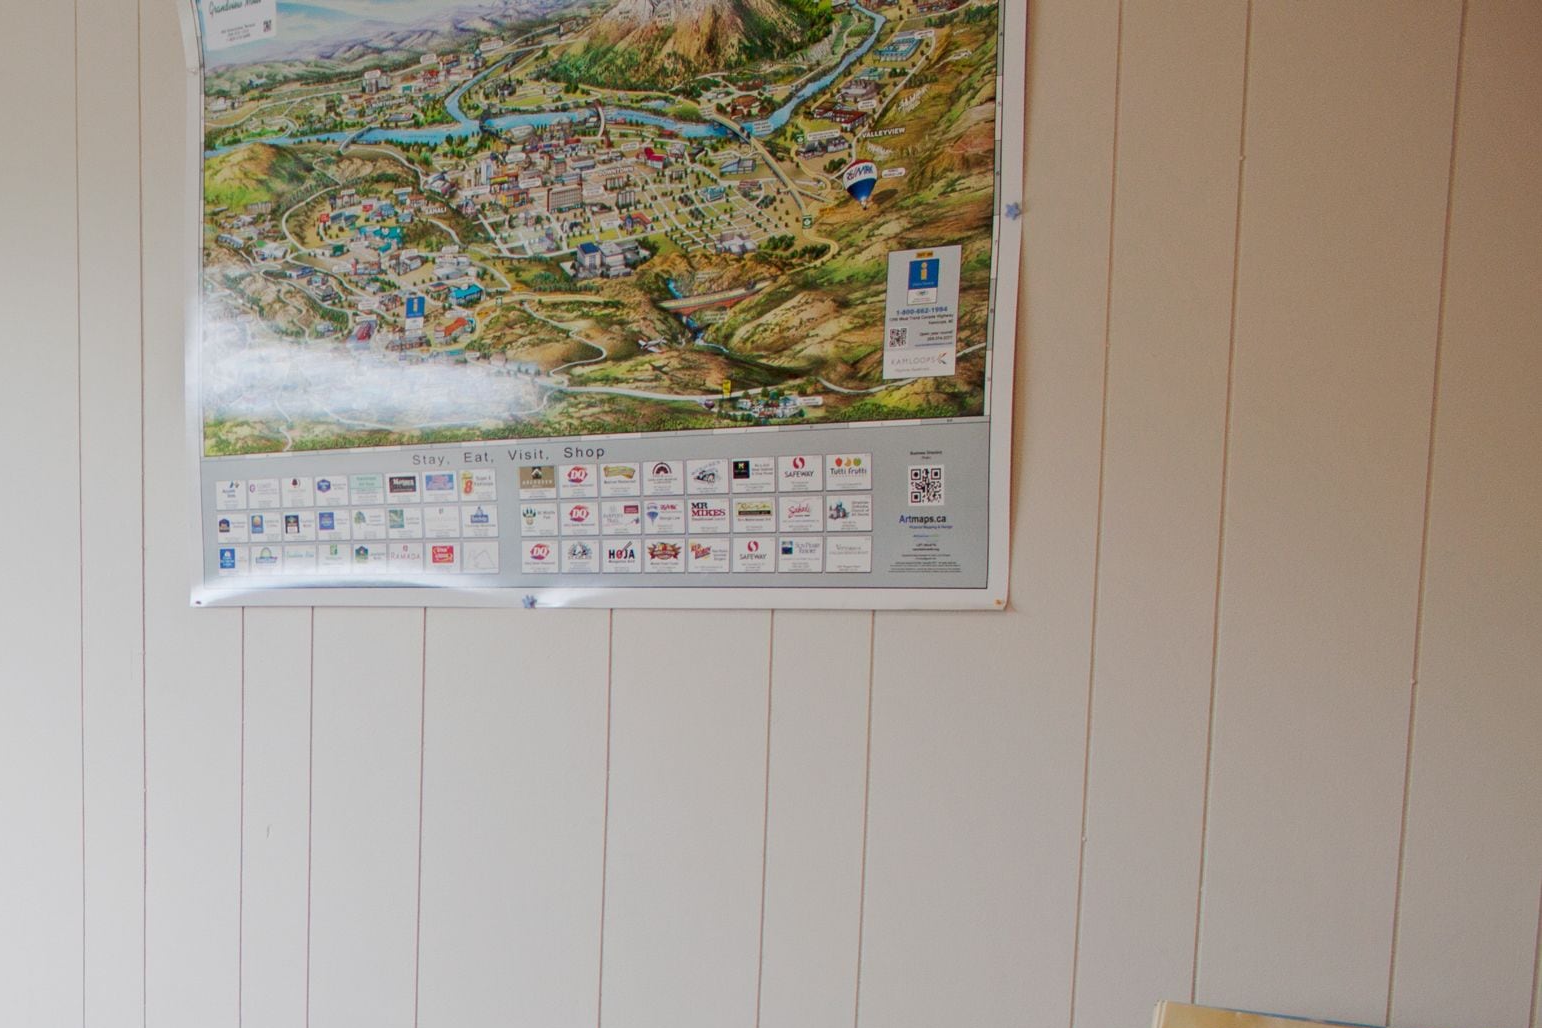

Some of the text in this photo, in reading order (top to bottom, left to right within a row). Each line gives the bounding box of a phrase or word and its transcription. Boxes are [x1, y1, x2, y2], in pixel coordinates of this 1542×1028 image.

[862, 127, 906, 138] VALLEYVIEW
[563, 446, 605, 460] Shop
[784, 471, 814, 479] SAFEWAY
[830, 468, 846, 476] Tutti
[691, 509, 726, 517] MIKES
[899, 514, 947, 524] Artmaps.ca
[608, 549, 635, 559] HOJA
[739, 553, 767, 561] SAFEWAY
